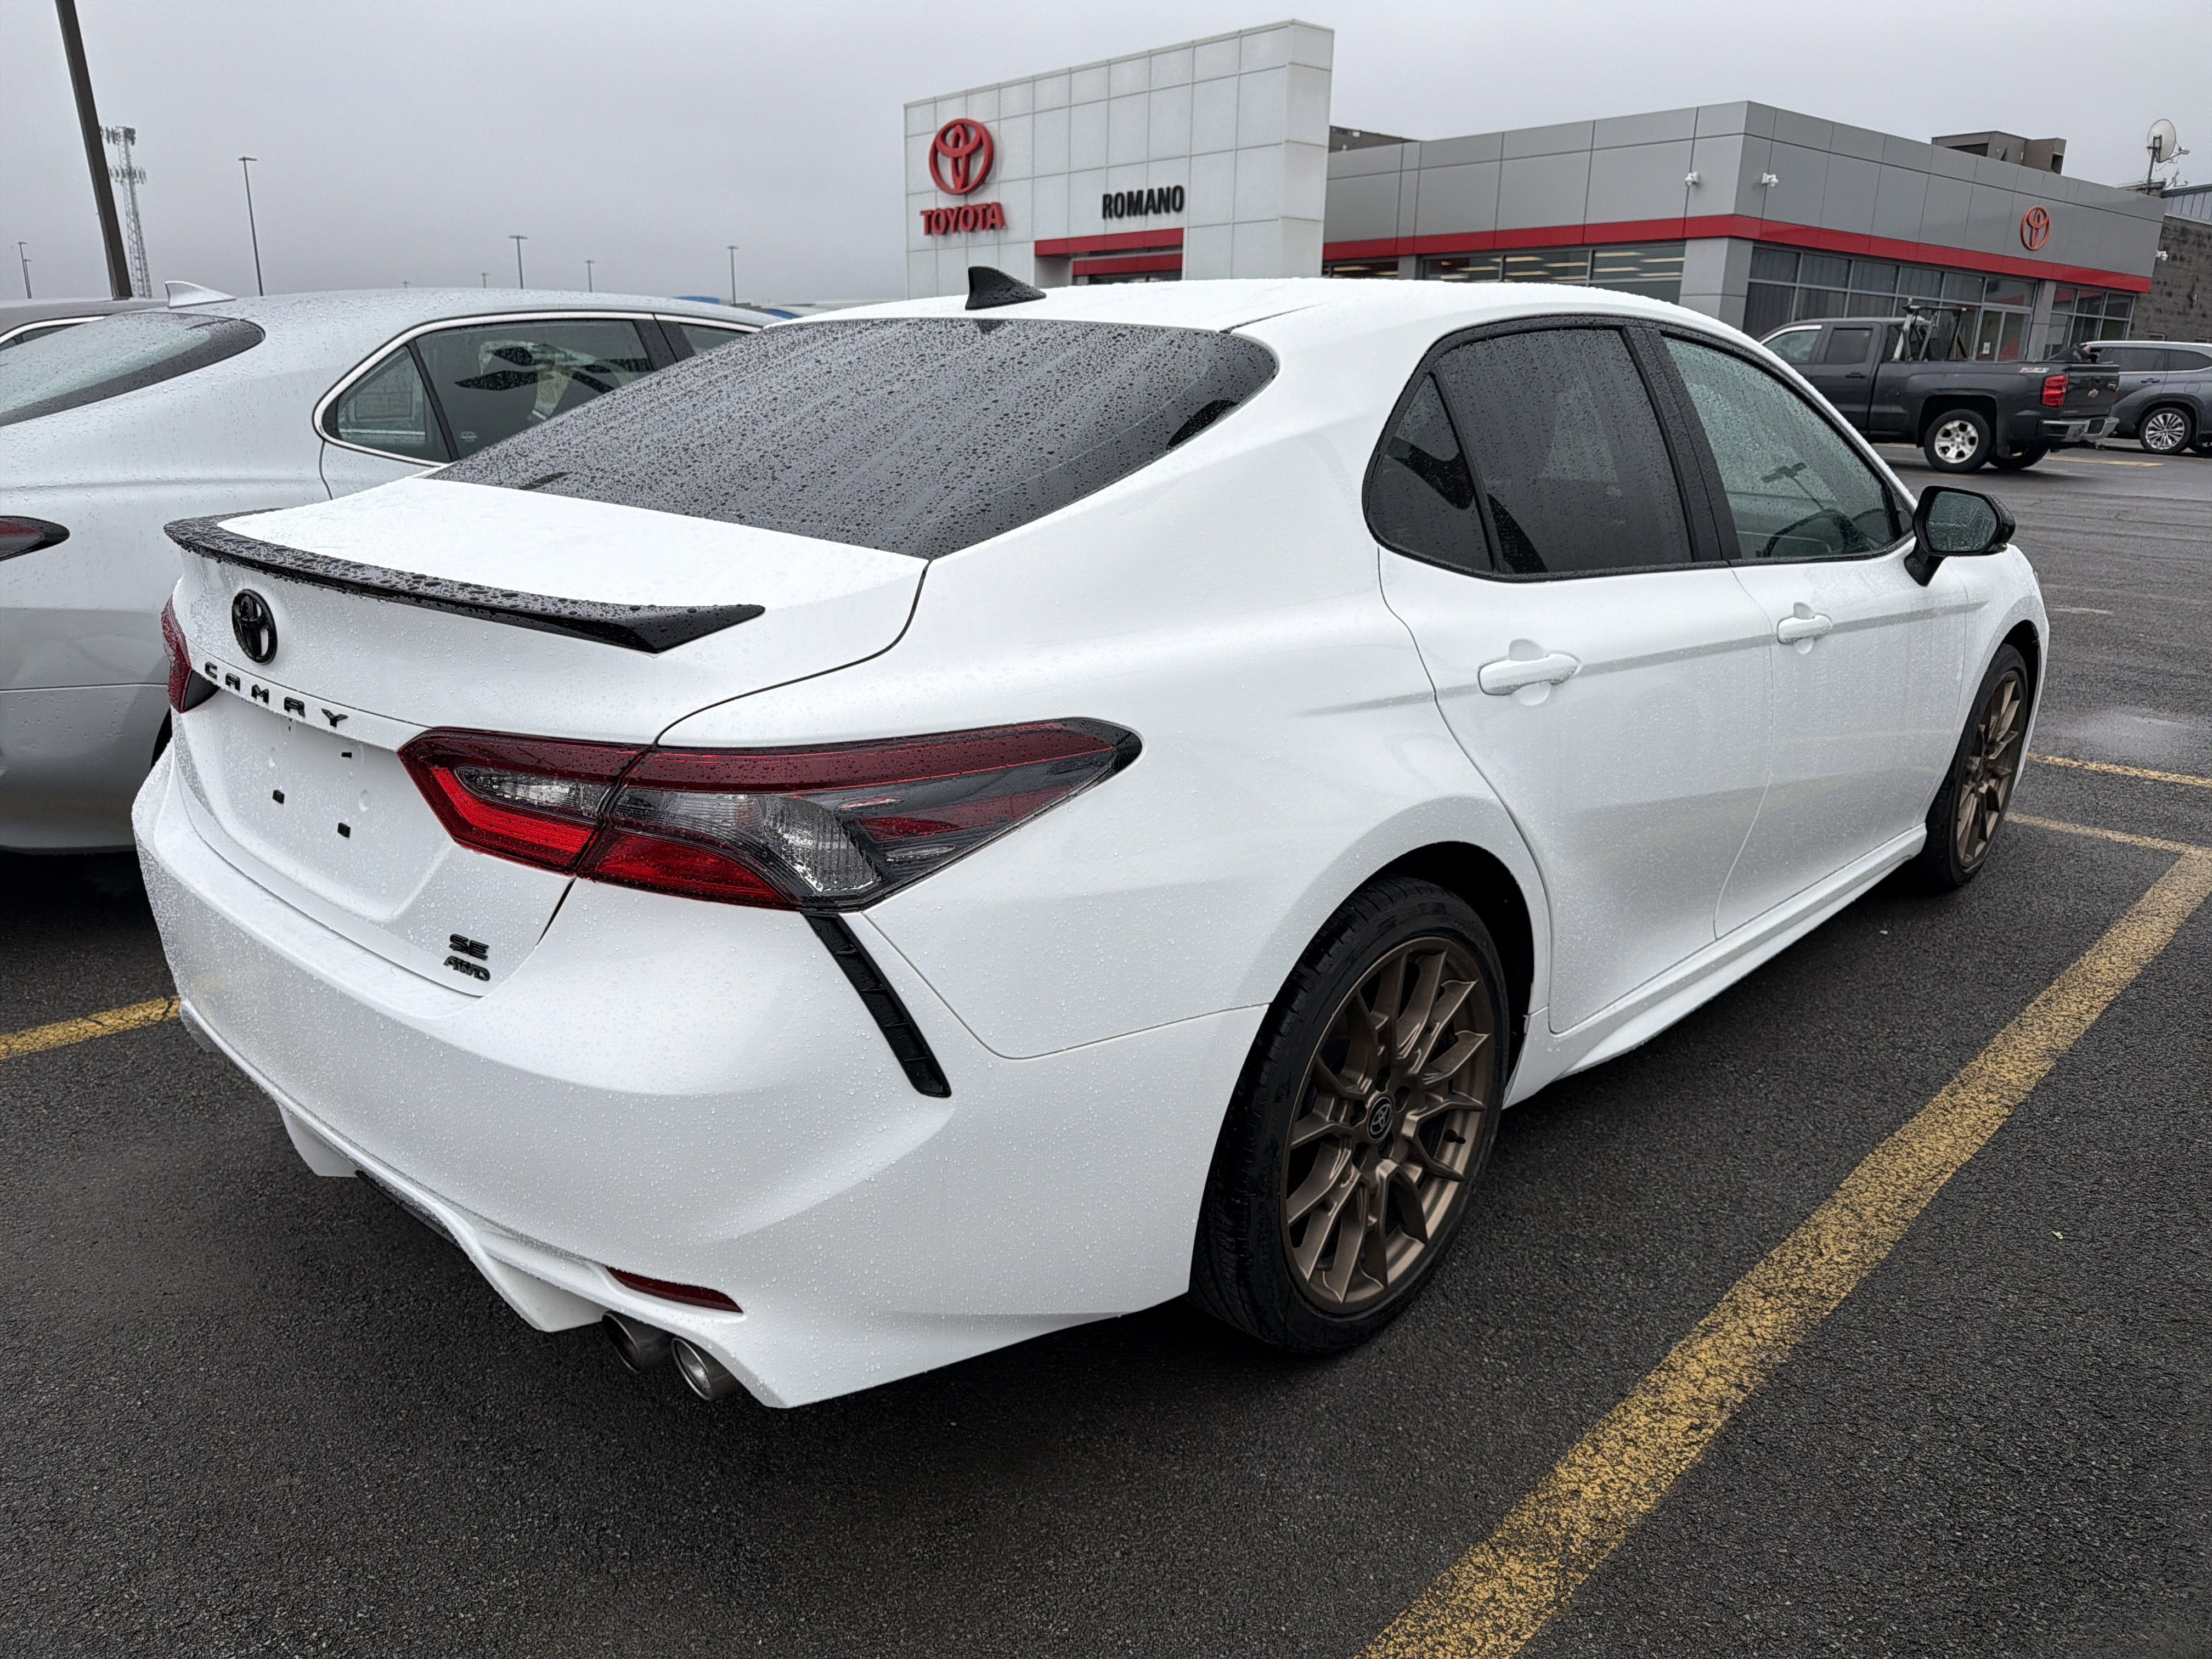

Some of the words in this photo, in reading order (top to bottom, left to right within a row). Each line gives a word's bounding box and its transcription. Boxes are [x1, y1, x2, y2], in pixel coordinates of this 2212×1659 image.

[921, 202, 1006, 236] TOYOTA
[1102, 185, 1184, 219] ROMANO
[205, 662, 348, 727] CAMRY
[449, 934, 489, 961] SE
[443, 955, 490, 981] AWD
